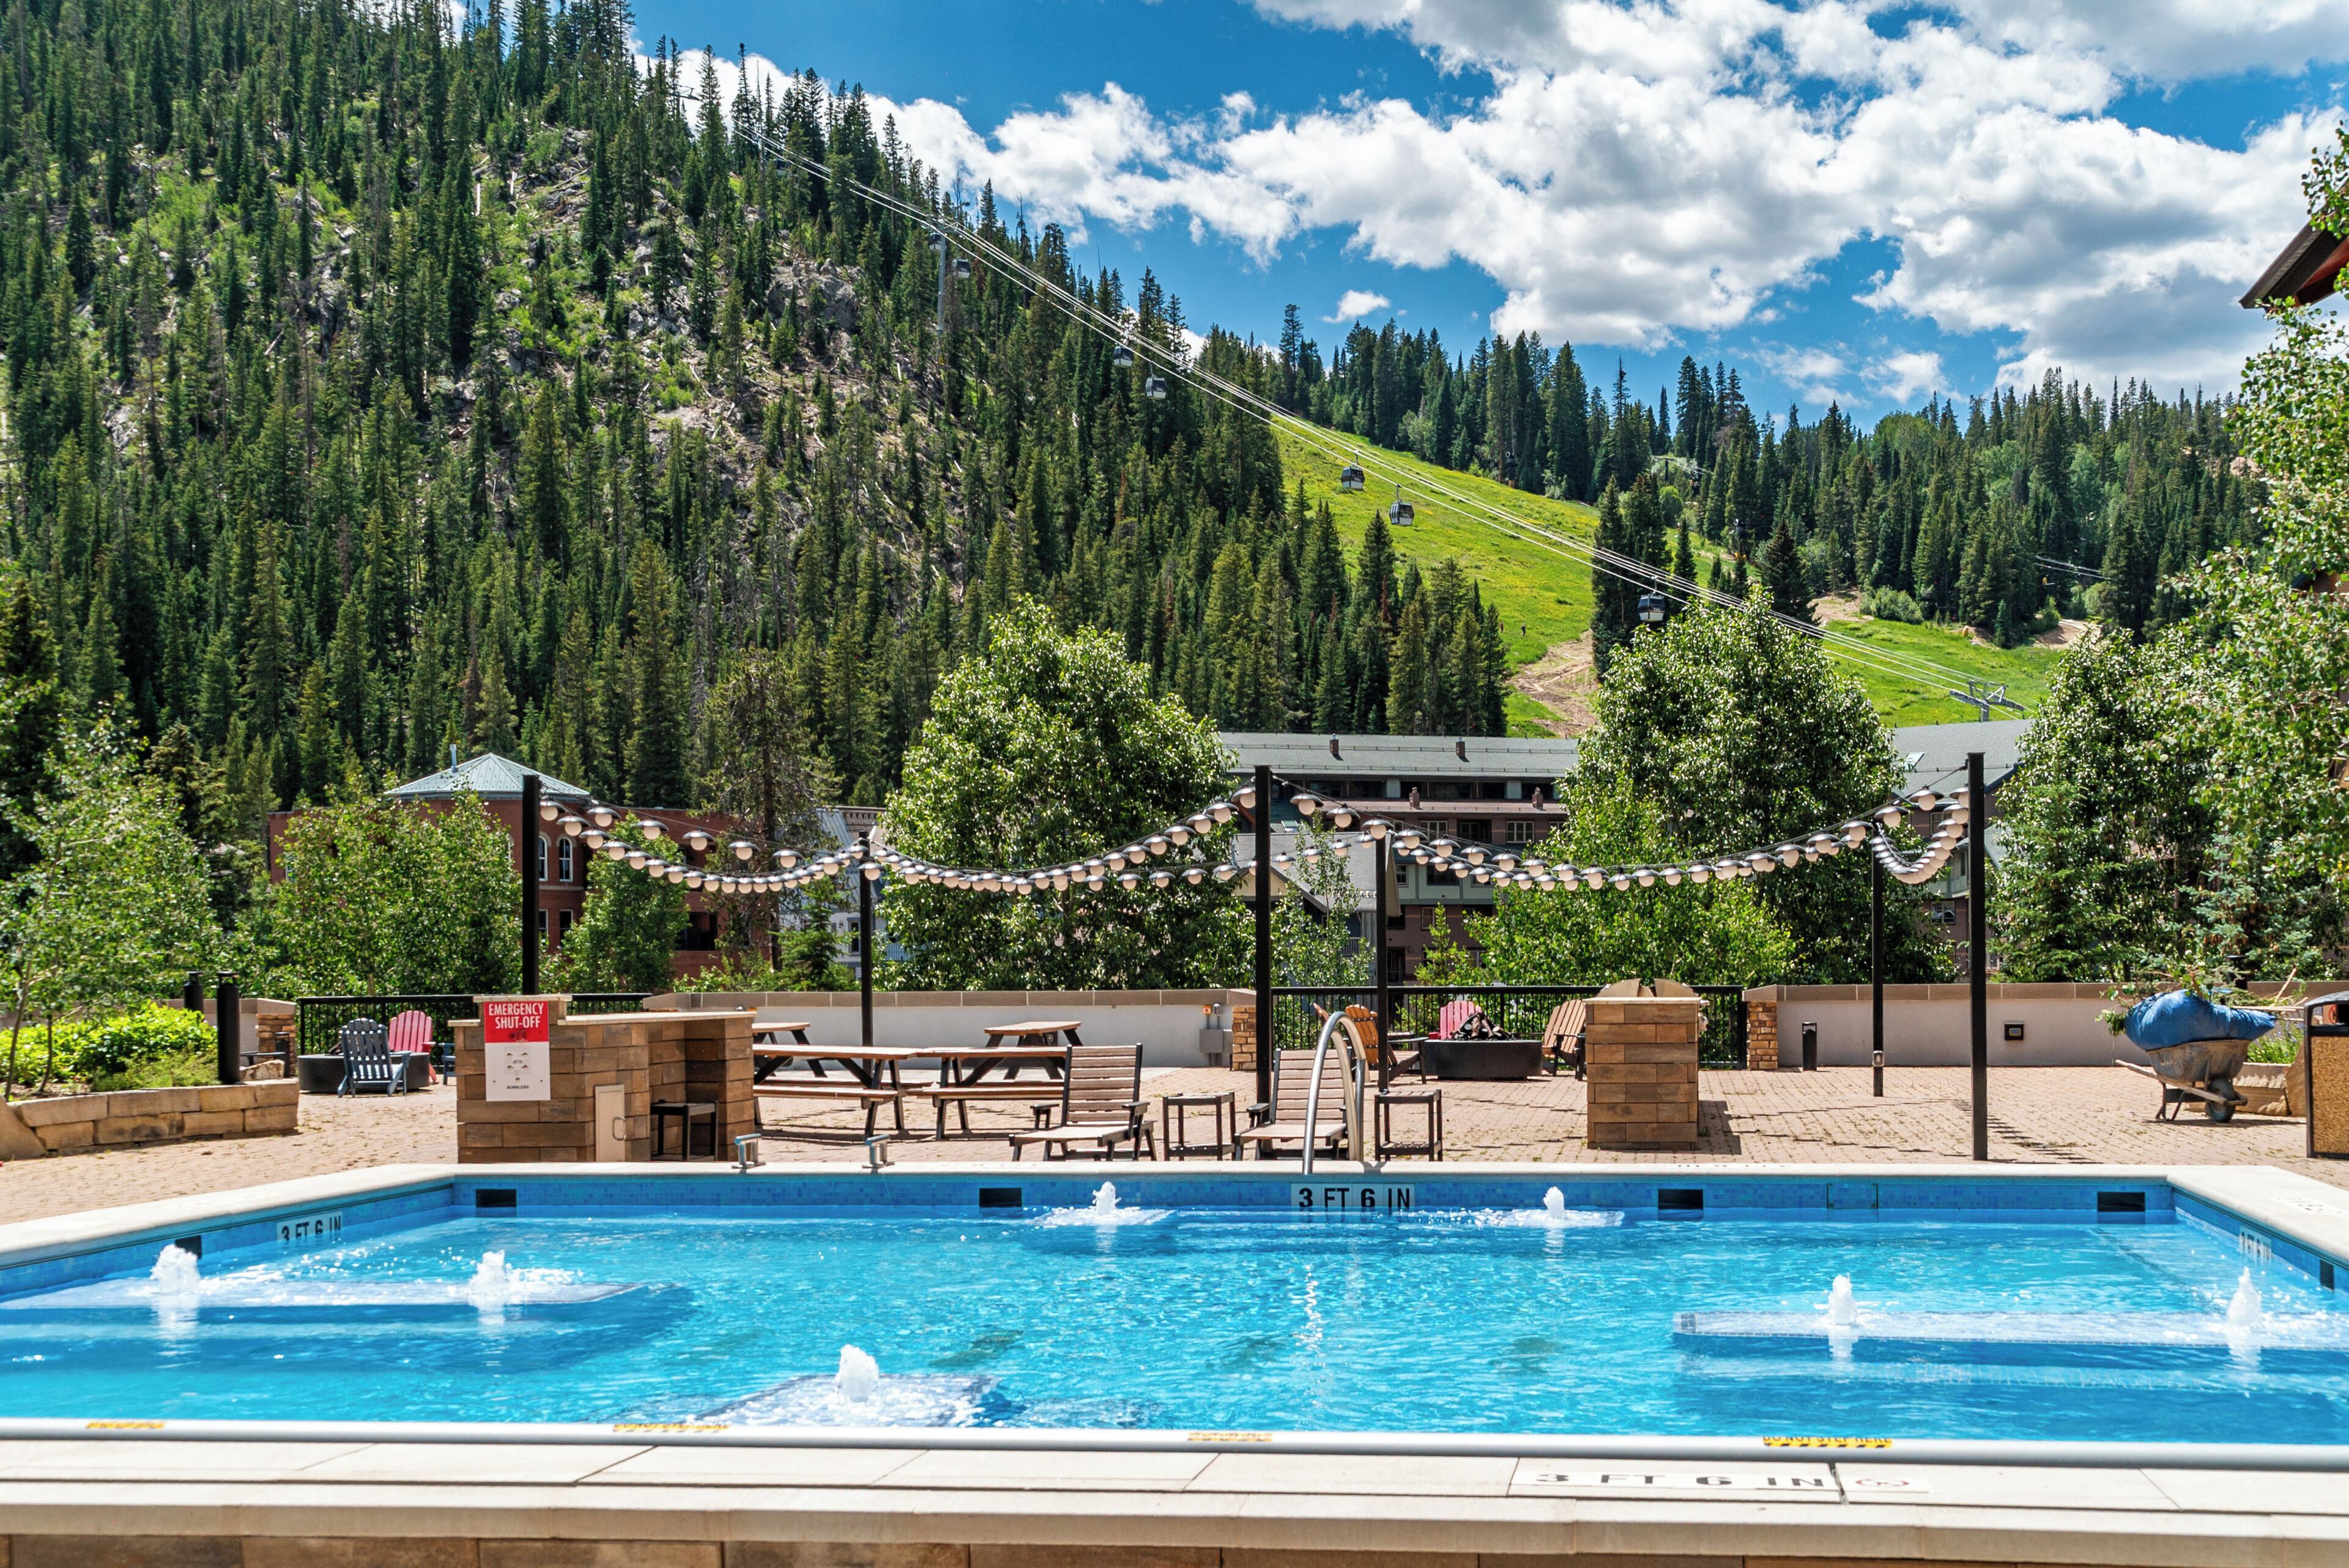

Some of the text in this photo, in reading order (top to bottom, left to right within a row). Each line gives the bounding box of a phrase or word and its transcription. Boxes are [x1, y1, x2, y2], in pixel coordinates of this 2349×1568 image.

[489, 1003, 543, 1016] EMERGENCY
[495, 1016, 540, 1029] SHUT-OFF
[1299, 1188, 1410, 1208] 3 FT 6 IN
[295, 1221, 310, 1238] FT
[329, 1216, 341, 1232] IN
[1535, 1474, 1824, 1487] 3 FT 6 IN
